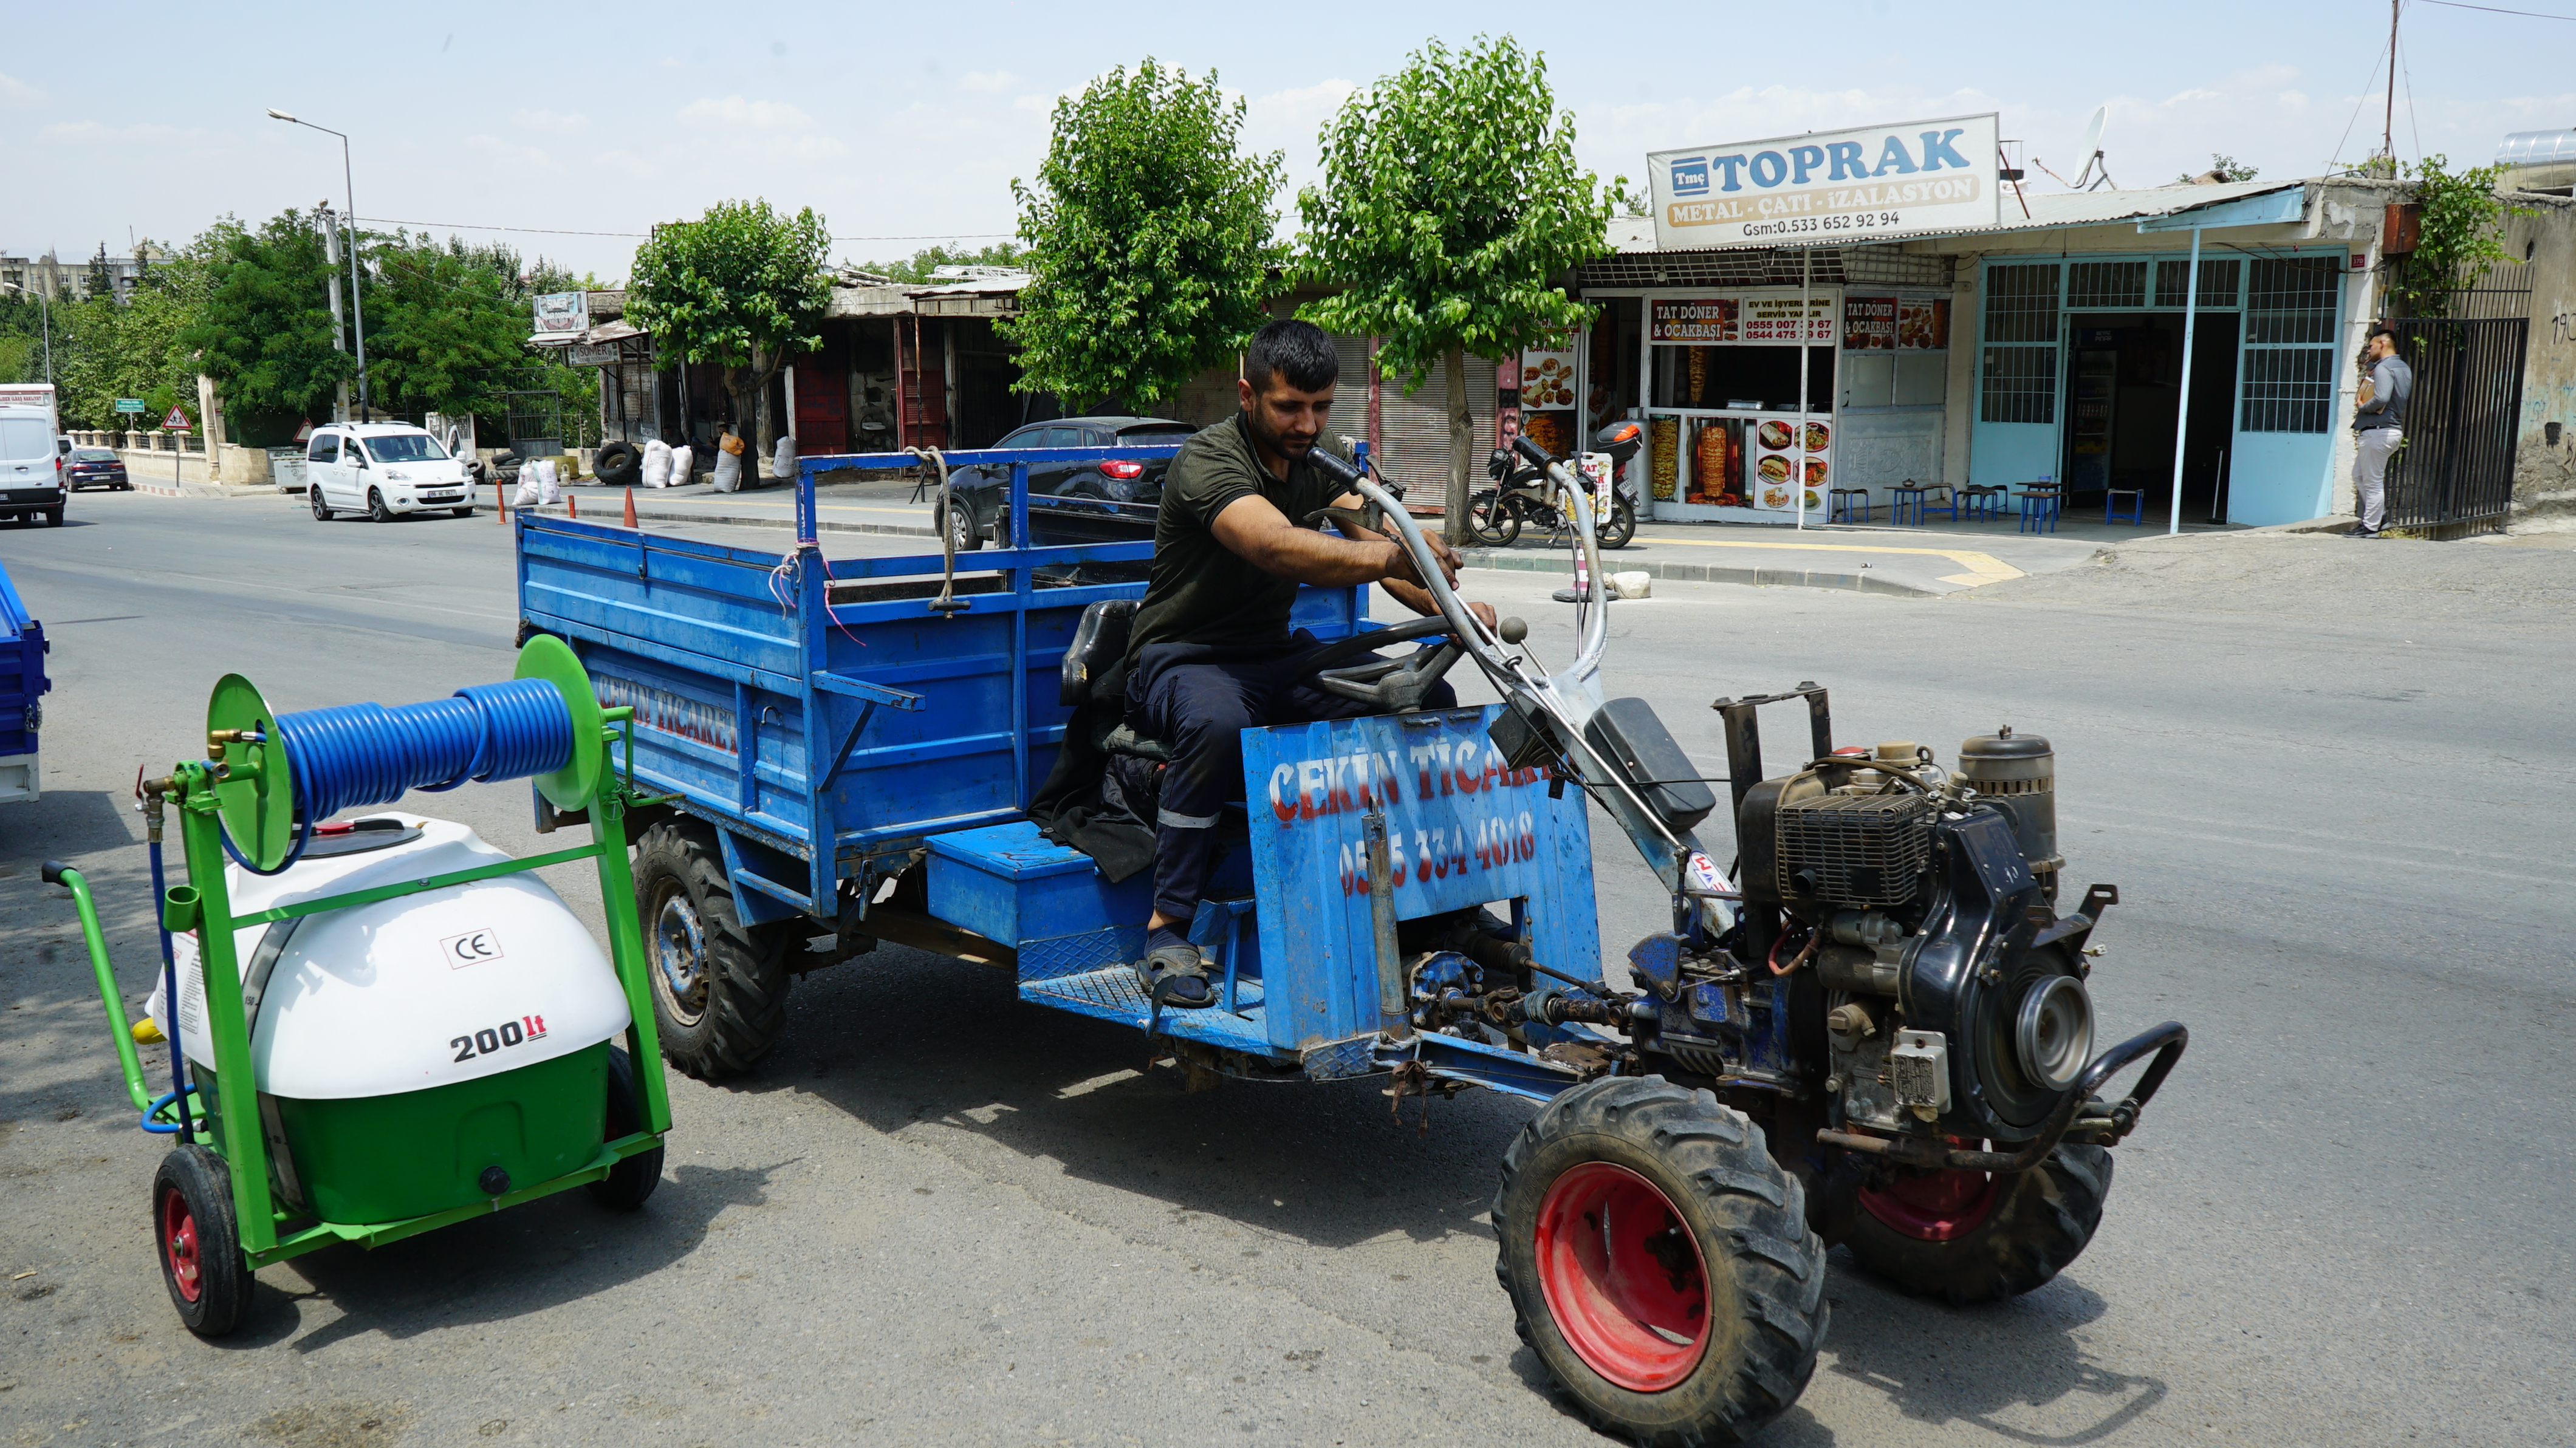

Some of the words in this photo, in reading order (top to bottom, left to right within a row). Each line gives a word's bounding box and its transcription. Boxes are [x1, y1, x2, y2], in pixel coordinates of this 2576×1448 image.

[1675, 172, 1705, 185] Tmç
[1713, 129, 1970, 191] TOPRAK
[1673, 201, 1743, 223] METAL
[1758, 194, 1811, 220] ÇATI
[1743, 219, 1817, 236] Gsm:0.533
[1823, 216, 1850, 230] 652
[1856, 214, 1874, 227] 92
[1880, 211, 1899, 225] 94
[1657, 306, 1677, 319] TAT
[1680, 302, 1719, 319] DÖNER
[1756, 309, 1786, 318] SERVİS
[1848, 303, 1863, 316] TAT
[1865, 301, 1893, 316] DÖNER
[1654, 323, 1662, 337] &
[1664, 323, 1721, 341] OCAKBAŞI
[1746, 320, 1773, 329] 0555
[1776, 320, 1797, 329] 007
[1817, 320, 1832, 329] 67
[1845, 321, 1851, 333] &
[1852, 321, 1894, 337] OCAKBAŞI
[1269, 747, 1400, 828] ÇEKİN
[1338, 832, 1406, 898] 055
[1414, 824, 1467, 883] 334
[1476, 811, 1535, 869] 4018
[455, 934, 493, 960] CE
[245, 995, 255, 1006] 150
